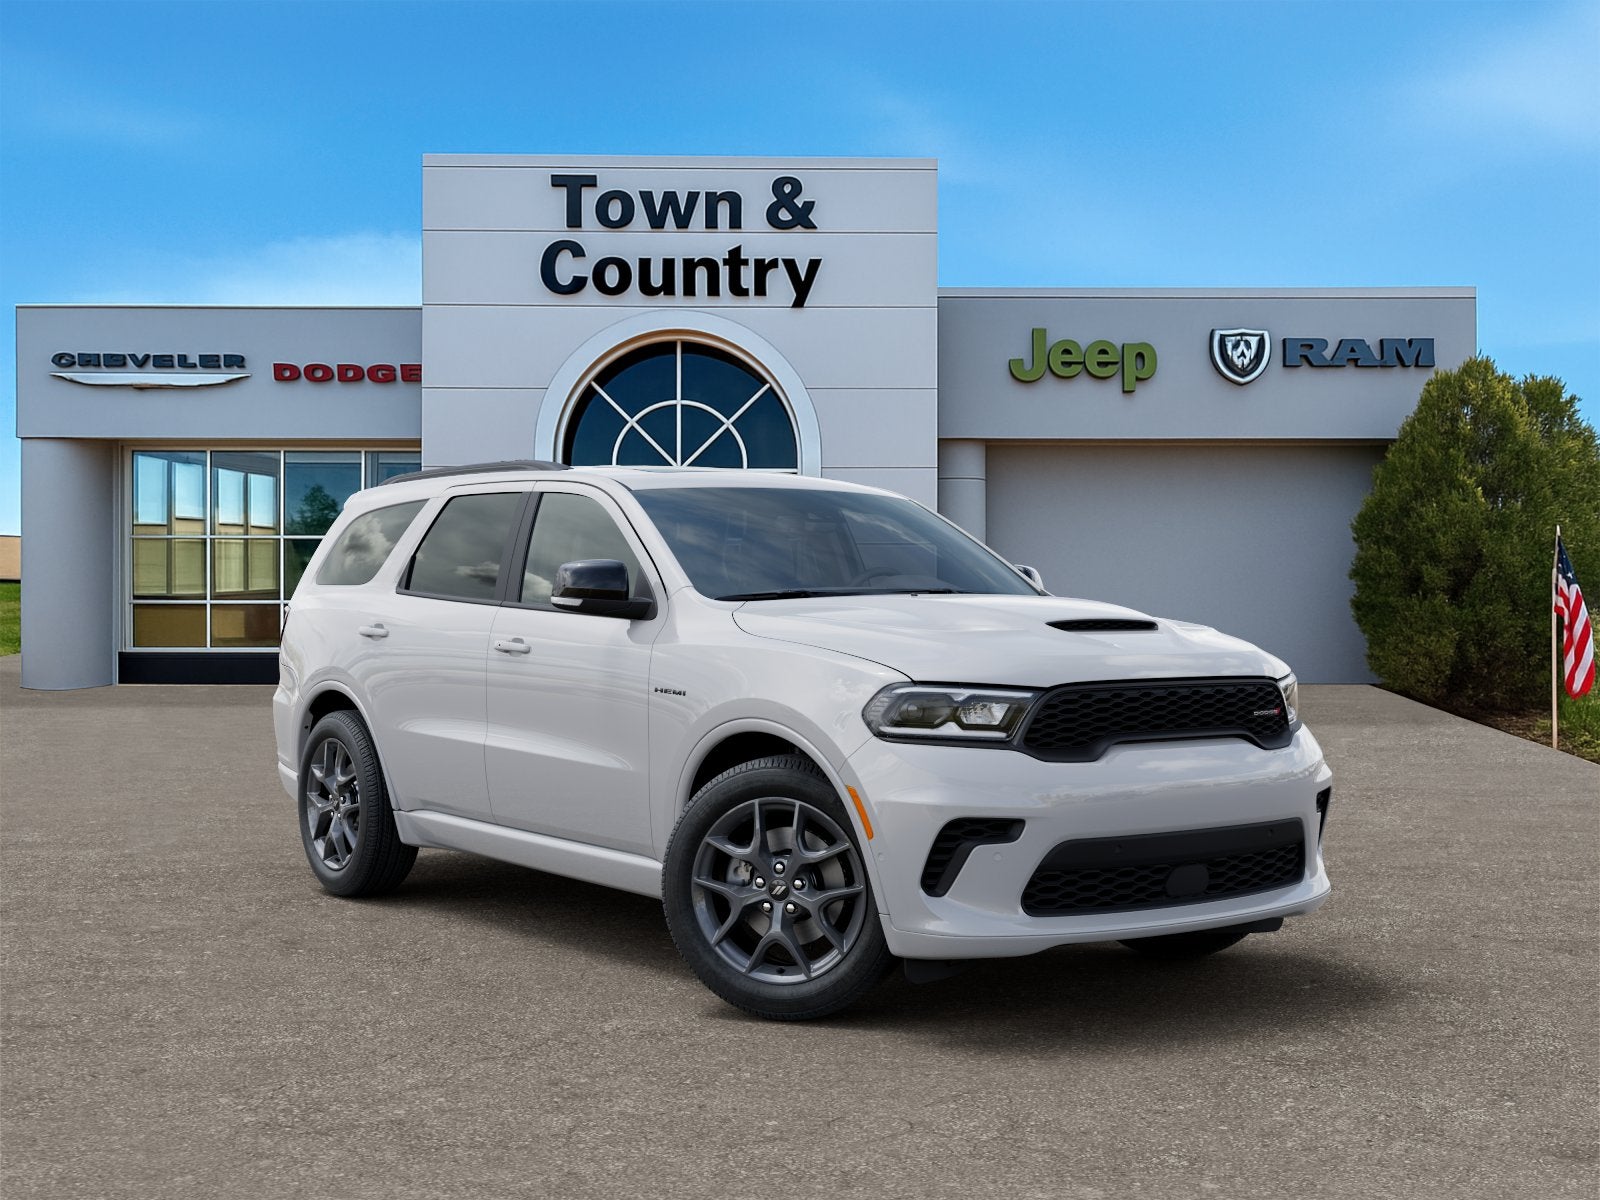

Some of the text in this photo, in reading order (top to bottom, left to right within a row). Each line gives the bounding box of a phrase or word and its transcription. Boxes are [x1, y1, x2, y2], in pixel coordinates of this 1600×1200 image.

[550, 174, 818, 230] Town &
[540, 239, 822, 308] Country
[273, 363, 421, 383] DODGE
[1009, 328, 1157, 392] Jeep
[1283, 338, 1436, 367] RAM
[654, 687, 687, 696] HEMI
